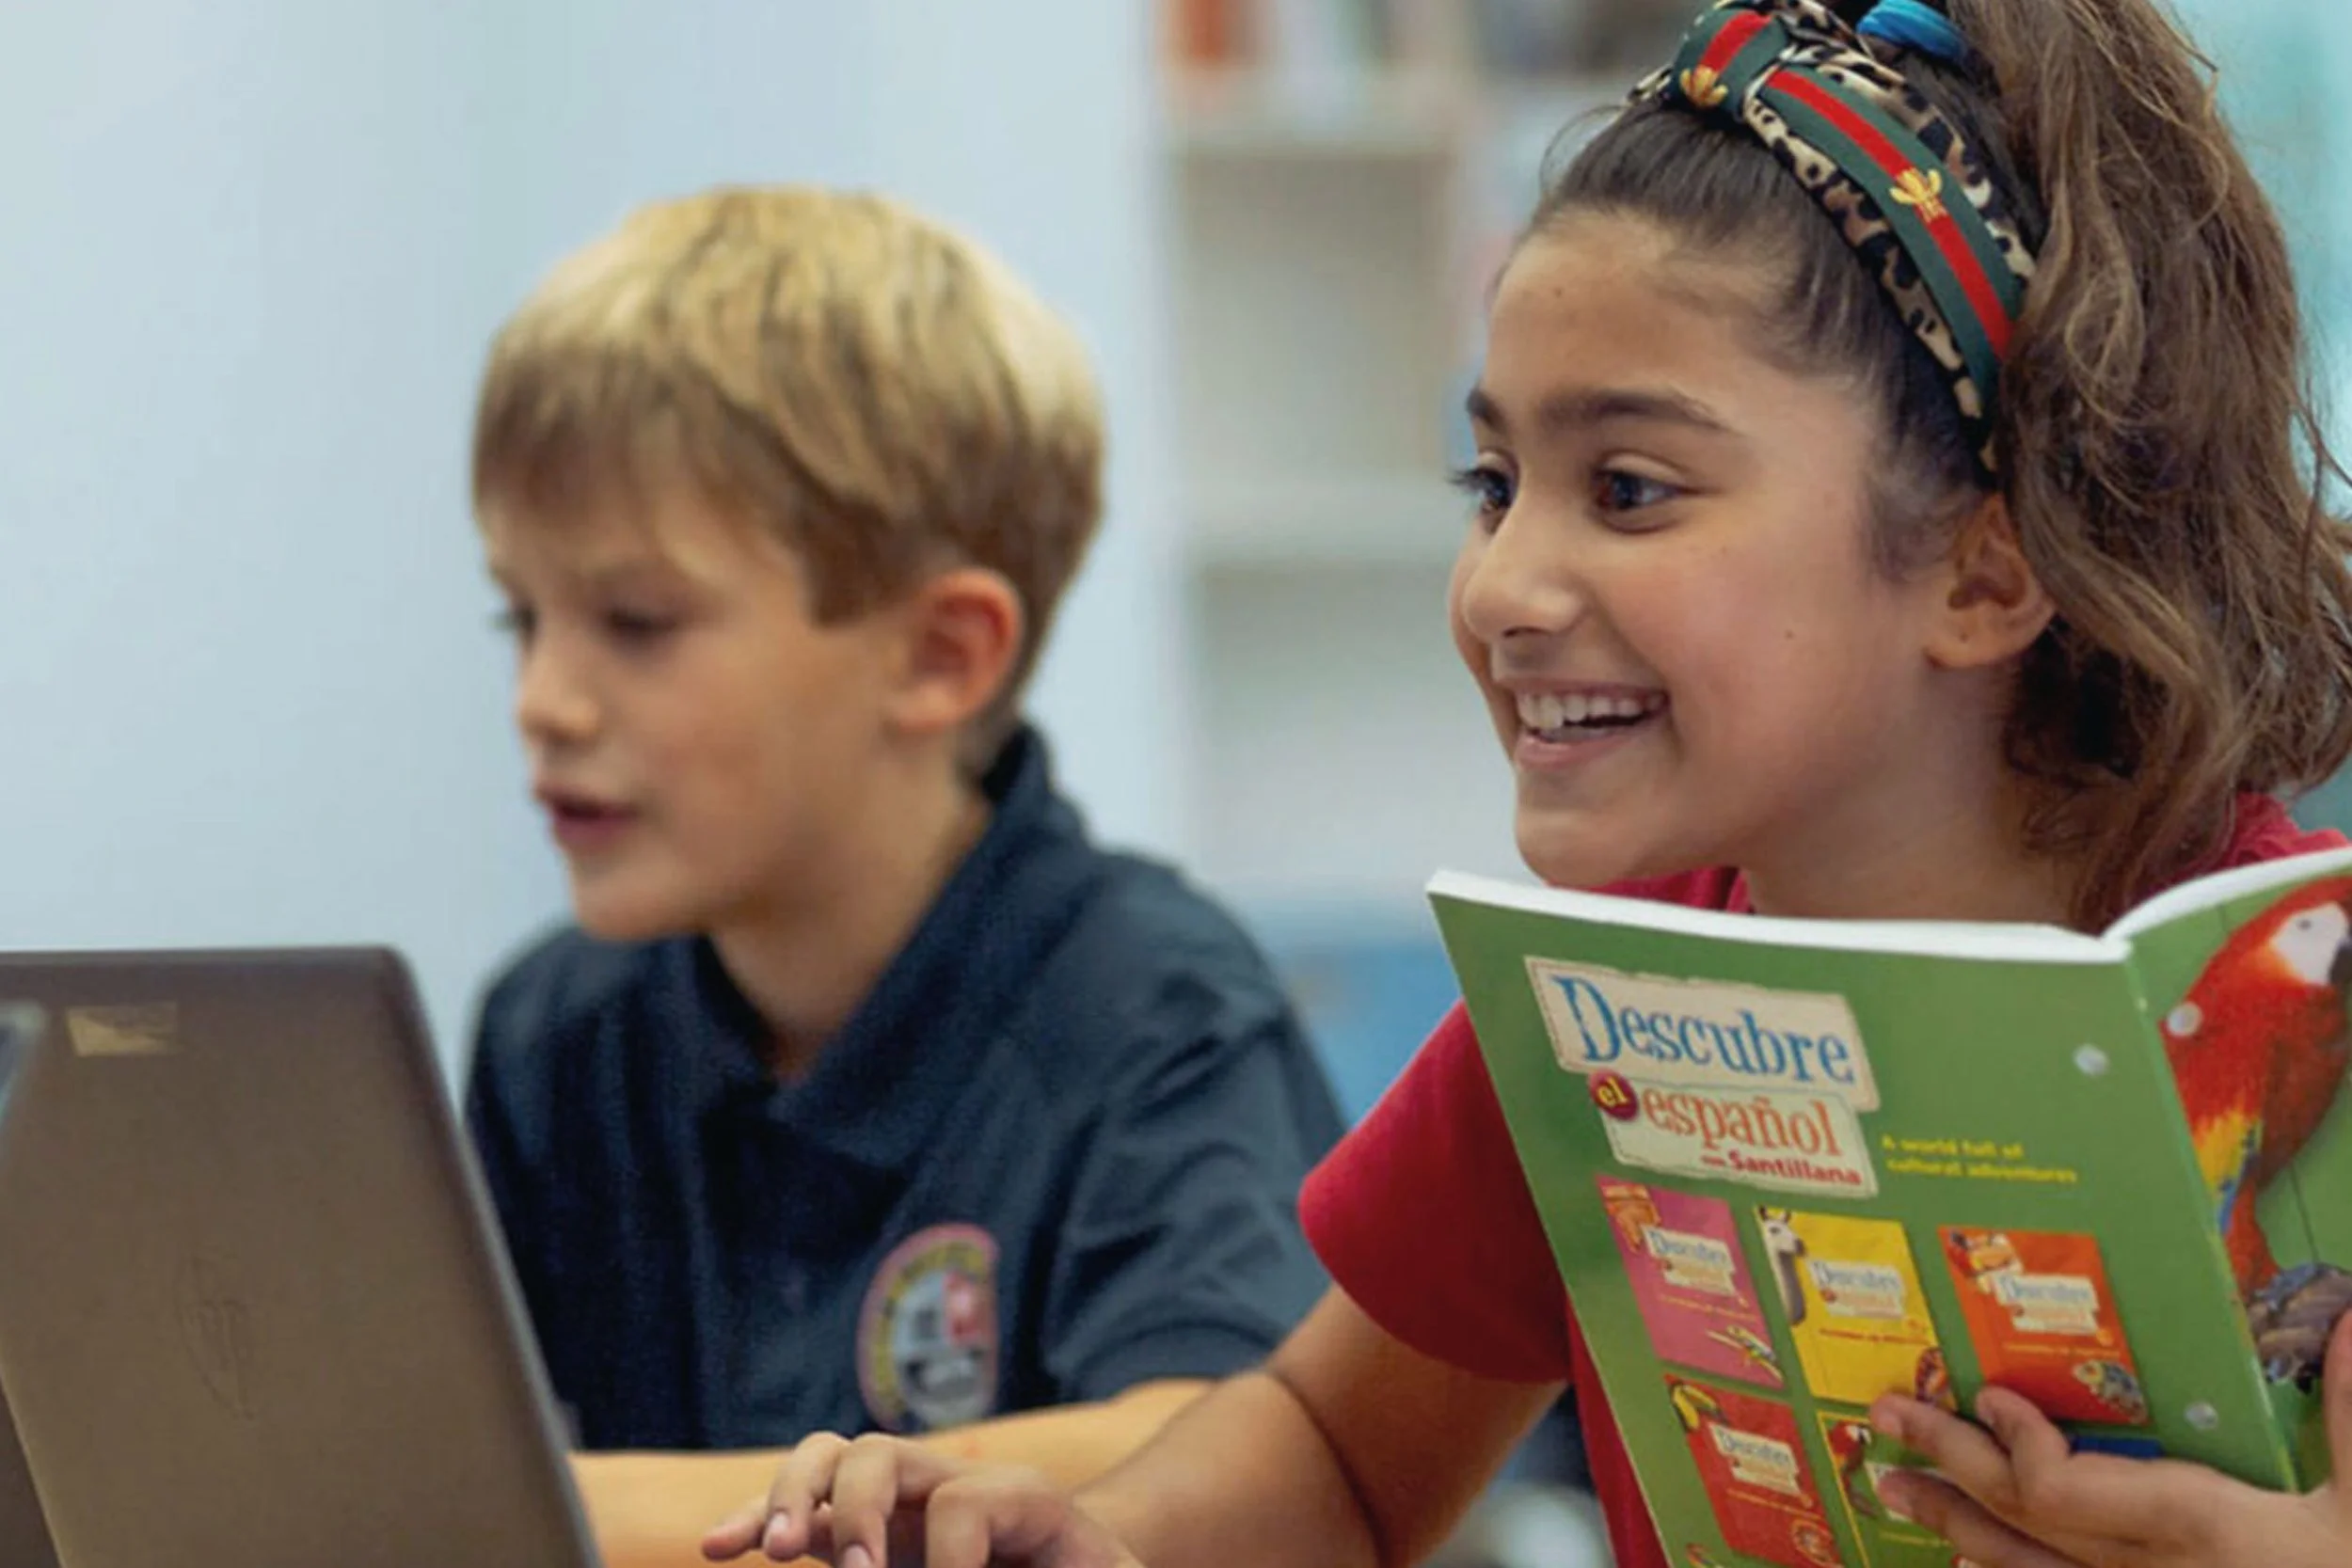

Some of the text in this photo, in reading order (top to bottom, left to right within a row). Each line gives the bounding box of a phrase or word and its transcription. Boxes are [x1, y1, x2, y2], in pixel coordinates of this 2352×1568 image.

[1550, 974, 1855, 1085] Descubre
[1596, 1075, 1844, 1157] el español
[1727, 1149, 1864, 1186] Santillana
